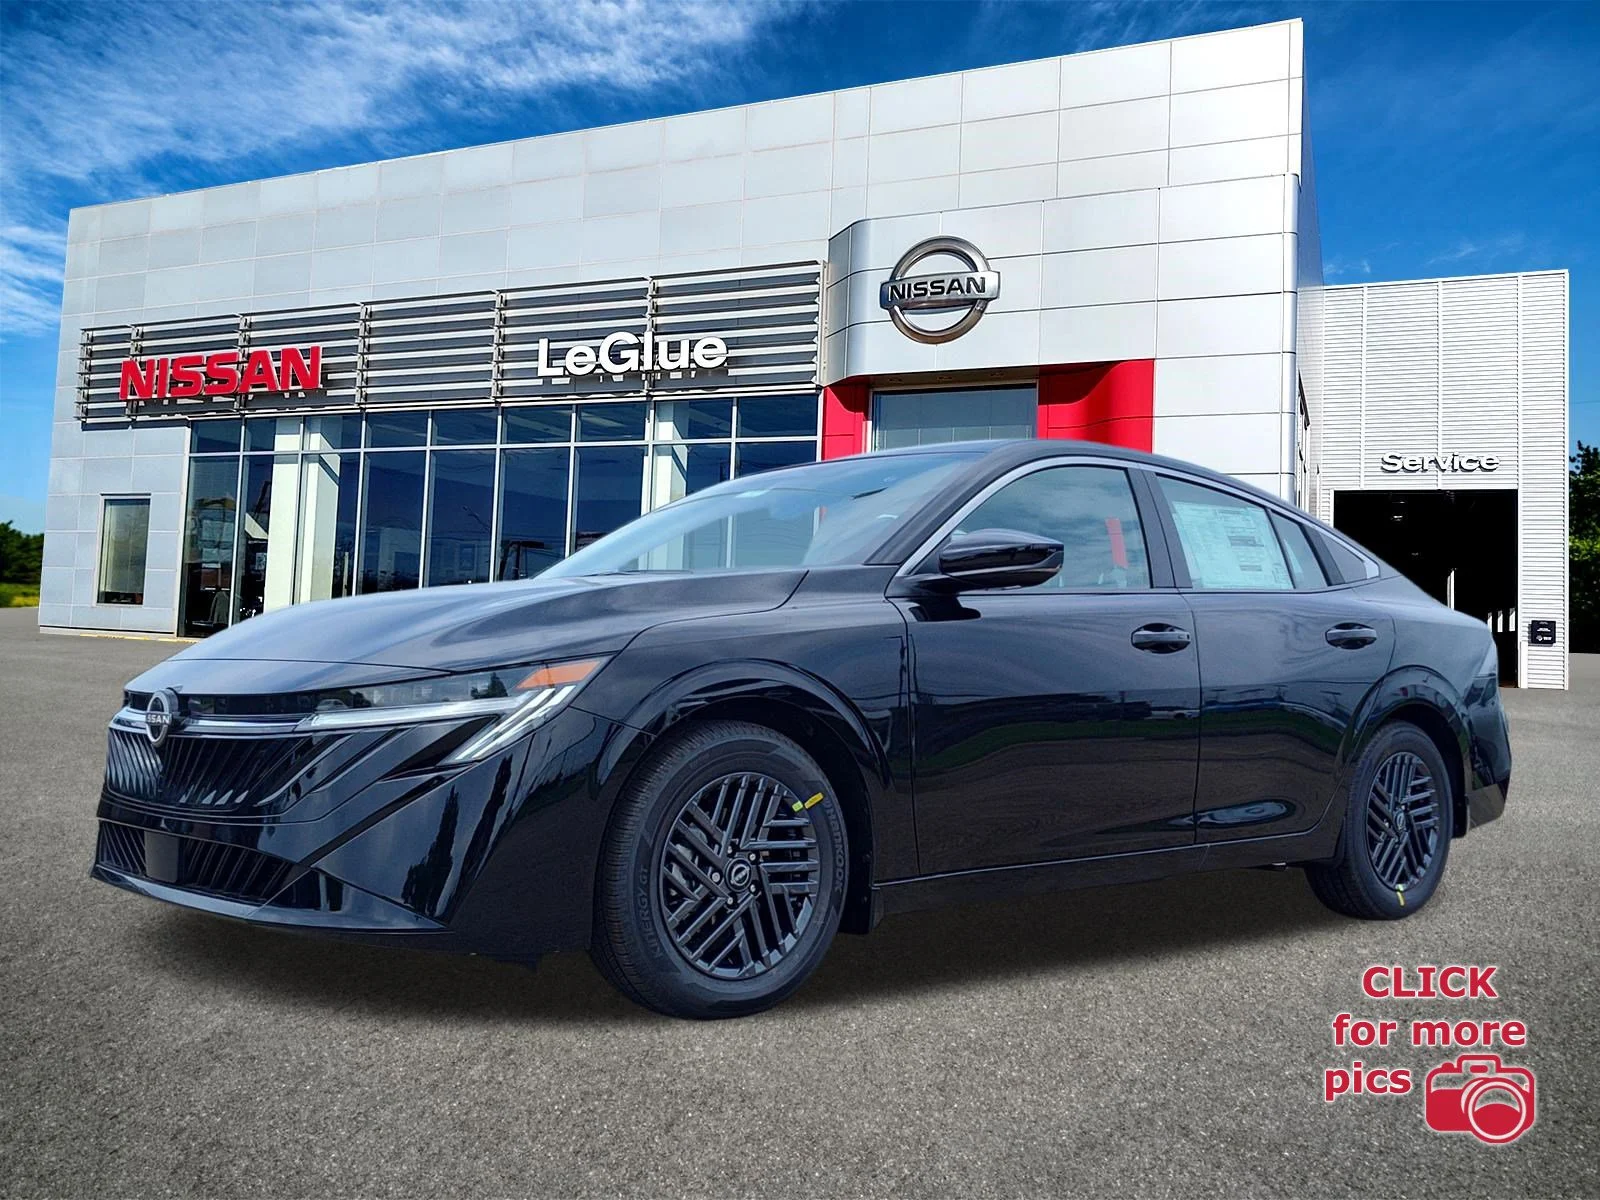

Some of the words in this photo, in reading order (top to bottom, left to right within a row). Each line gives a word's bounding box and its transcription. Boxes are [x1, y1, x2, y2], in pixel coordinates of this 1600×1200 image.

[888, 277, 986, 300] NISSAN
[537, 331, 729, 377] LeGlue
[119, 346, 322, 400] NISSAN
[1381, 451, 1500, 473] Service
